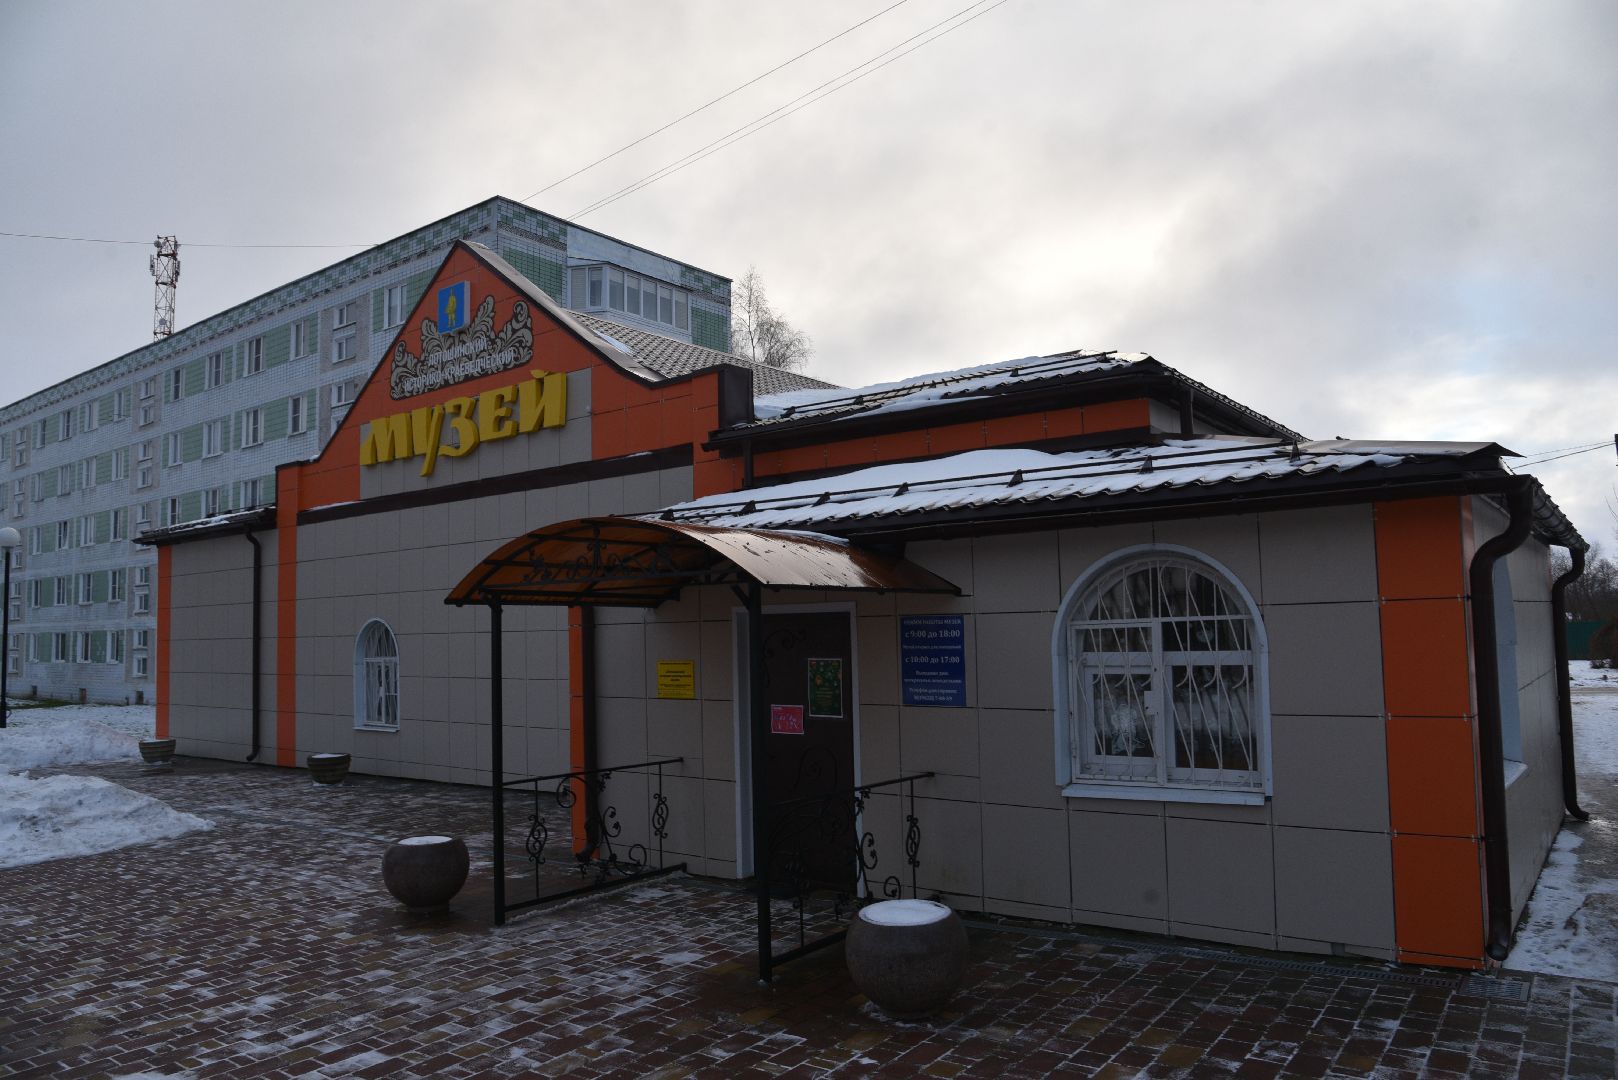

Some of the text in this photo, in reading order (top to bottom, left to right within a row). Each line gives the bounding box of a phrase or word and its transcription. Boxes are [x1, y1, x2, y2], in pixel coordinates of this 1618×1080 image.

[428, 336, 488, 367] ЛОТОШИНСКИЙ
[403, 347, 515, 392] ИСТОРИКО-КРАЕВЕДЧЕСКИЙ
[359, 369, 568, 477] МУЗЕЙ
[910, 630, 927, 638] 9:00
[927, 631, 938, 639] до
[939, 629, 961, 638] 18:00
[911, 656, 929, 664] 10:00
[941, 656, 960, 664] 17:00
